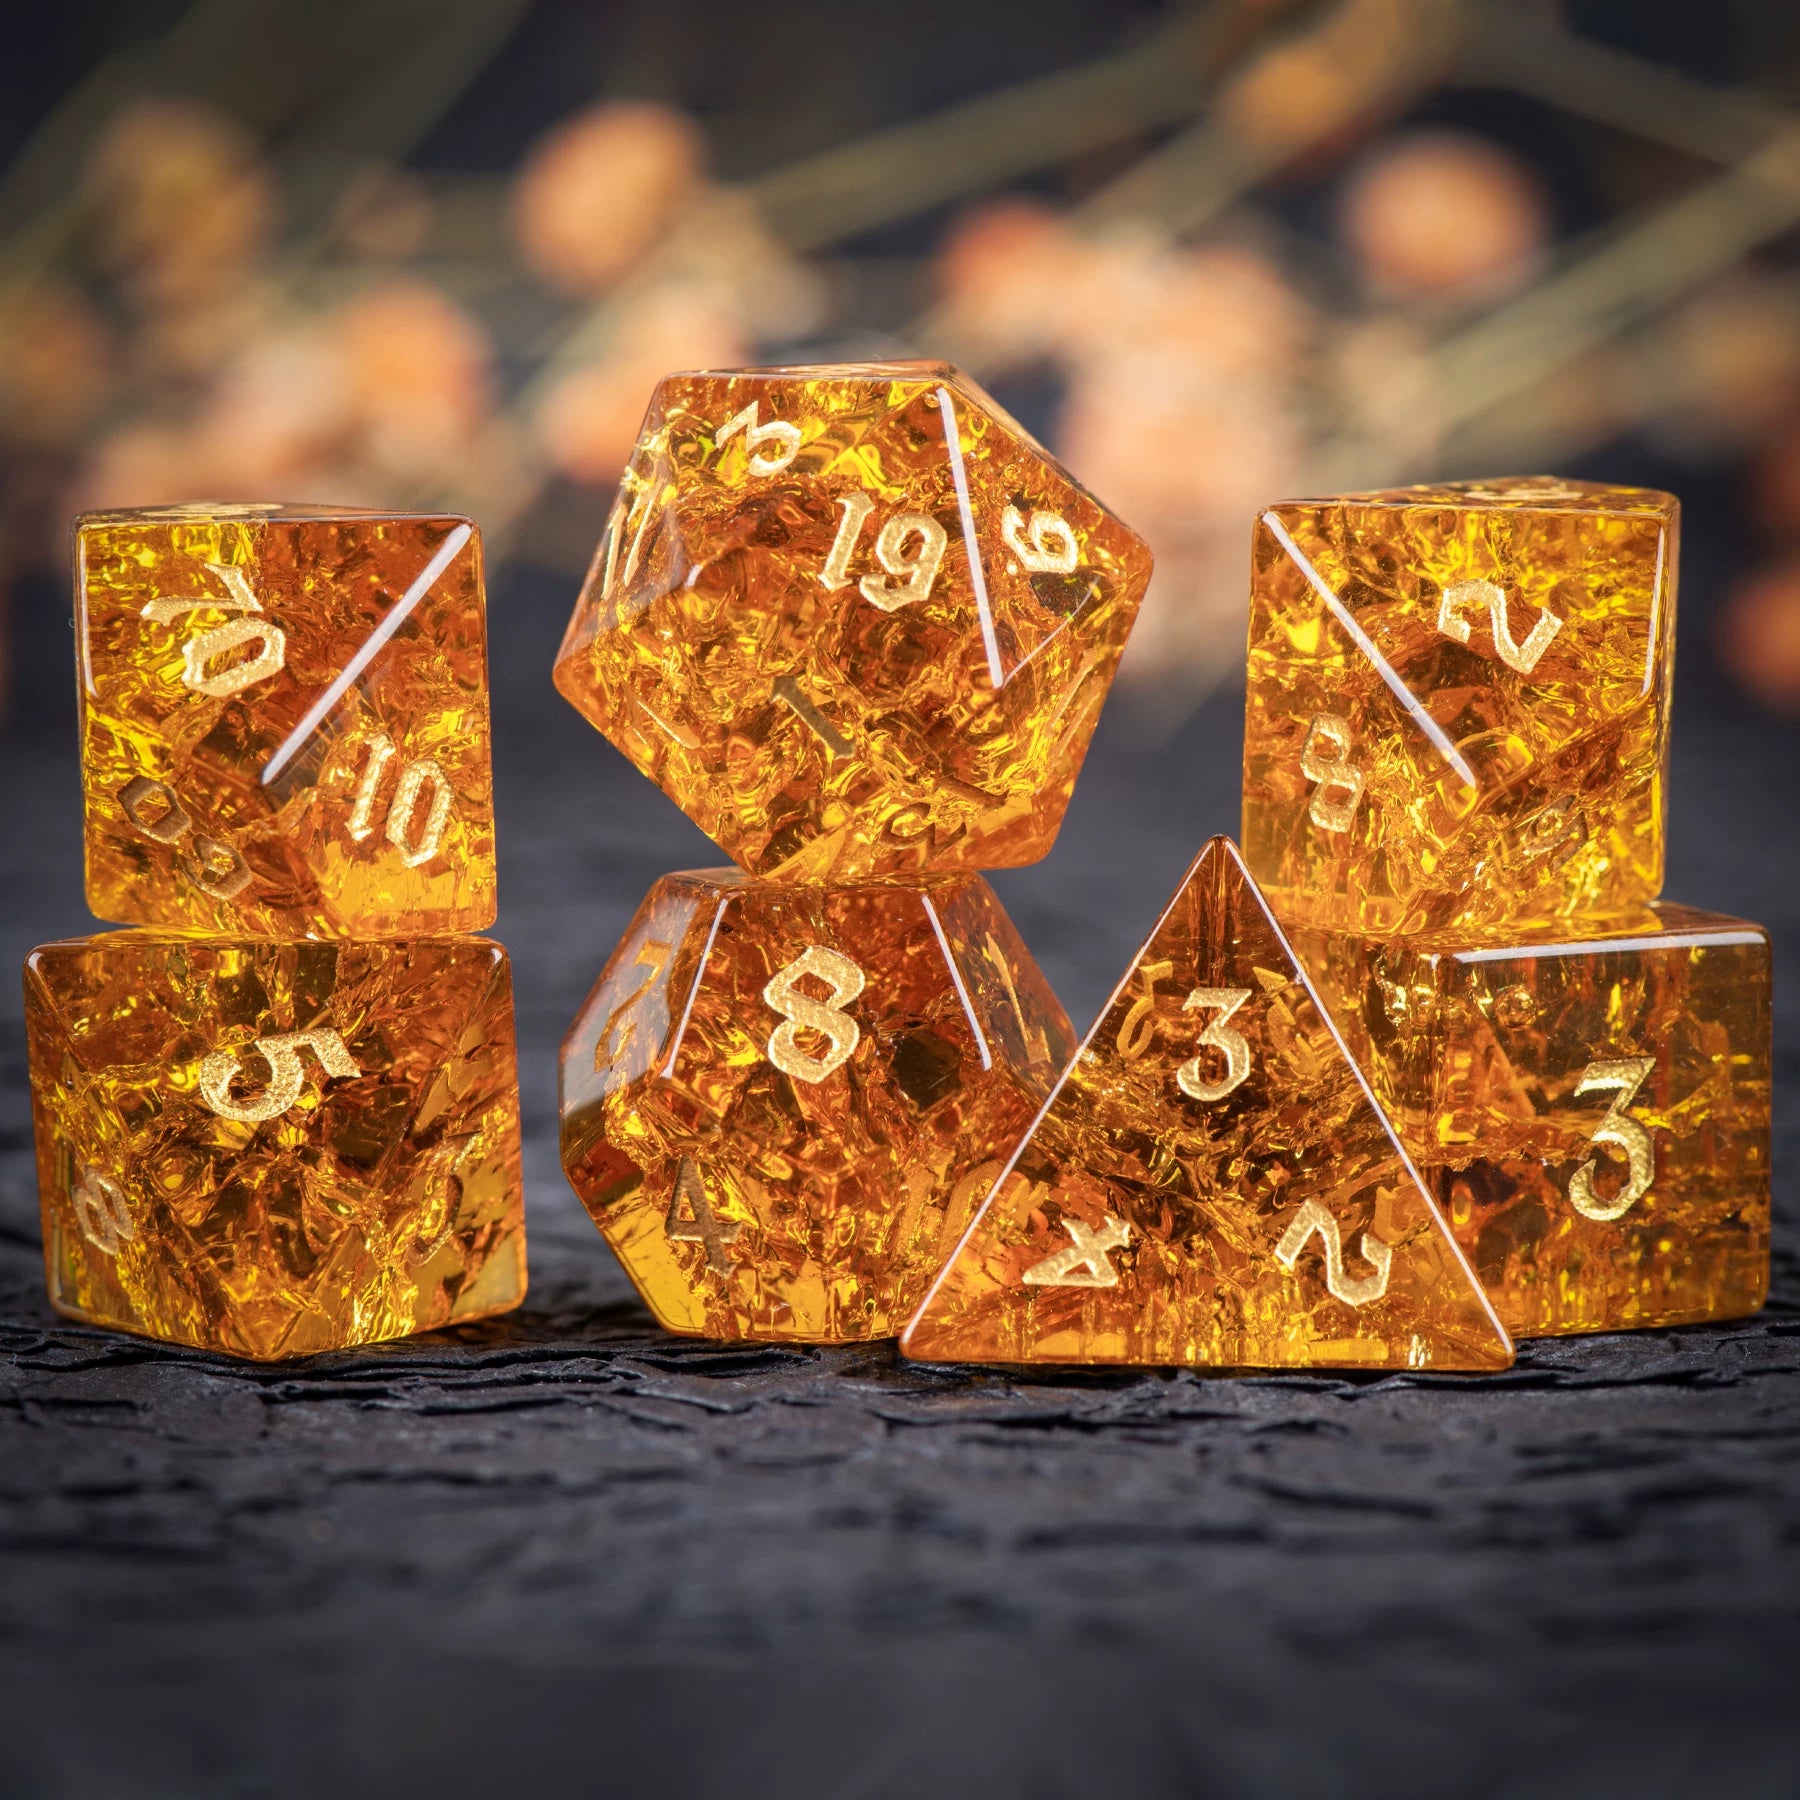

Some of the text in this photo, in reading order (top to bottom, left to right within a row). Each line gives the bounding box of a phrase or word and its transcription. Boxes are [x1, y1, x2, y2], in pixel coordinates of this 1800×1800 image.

[716, 401, 802, 477] 3
[817, 491, 948, 613] 19
[139, 562, 286, 697] 70
[1437, 578, 1563, 674] 2
[343, 730, 455, 869] 10
[1300, 712, 1364, 833] 8
[199, 1026, 362, 1122] 5
[763, 944, 866, 1085] 8
[1176, 987, 1252, 1101] 3
[1568, 1055, 1656, 1221] 3
[664, 1154, 743, 1279] 4
[1022, 1215, 1132, 1288] 4
[1274, 1199, 1393, 1306] 2
